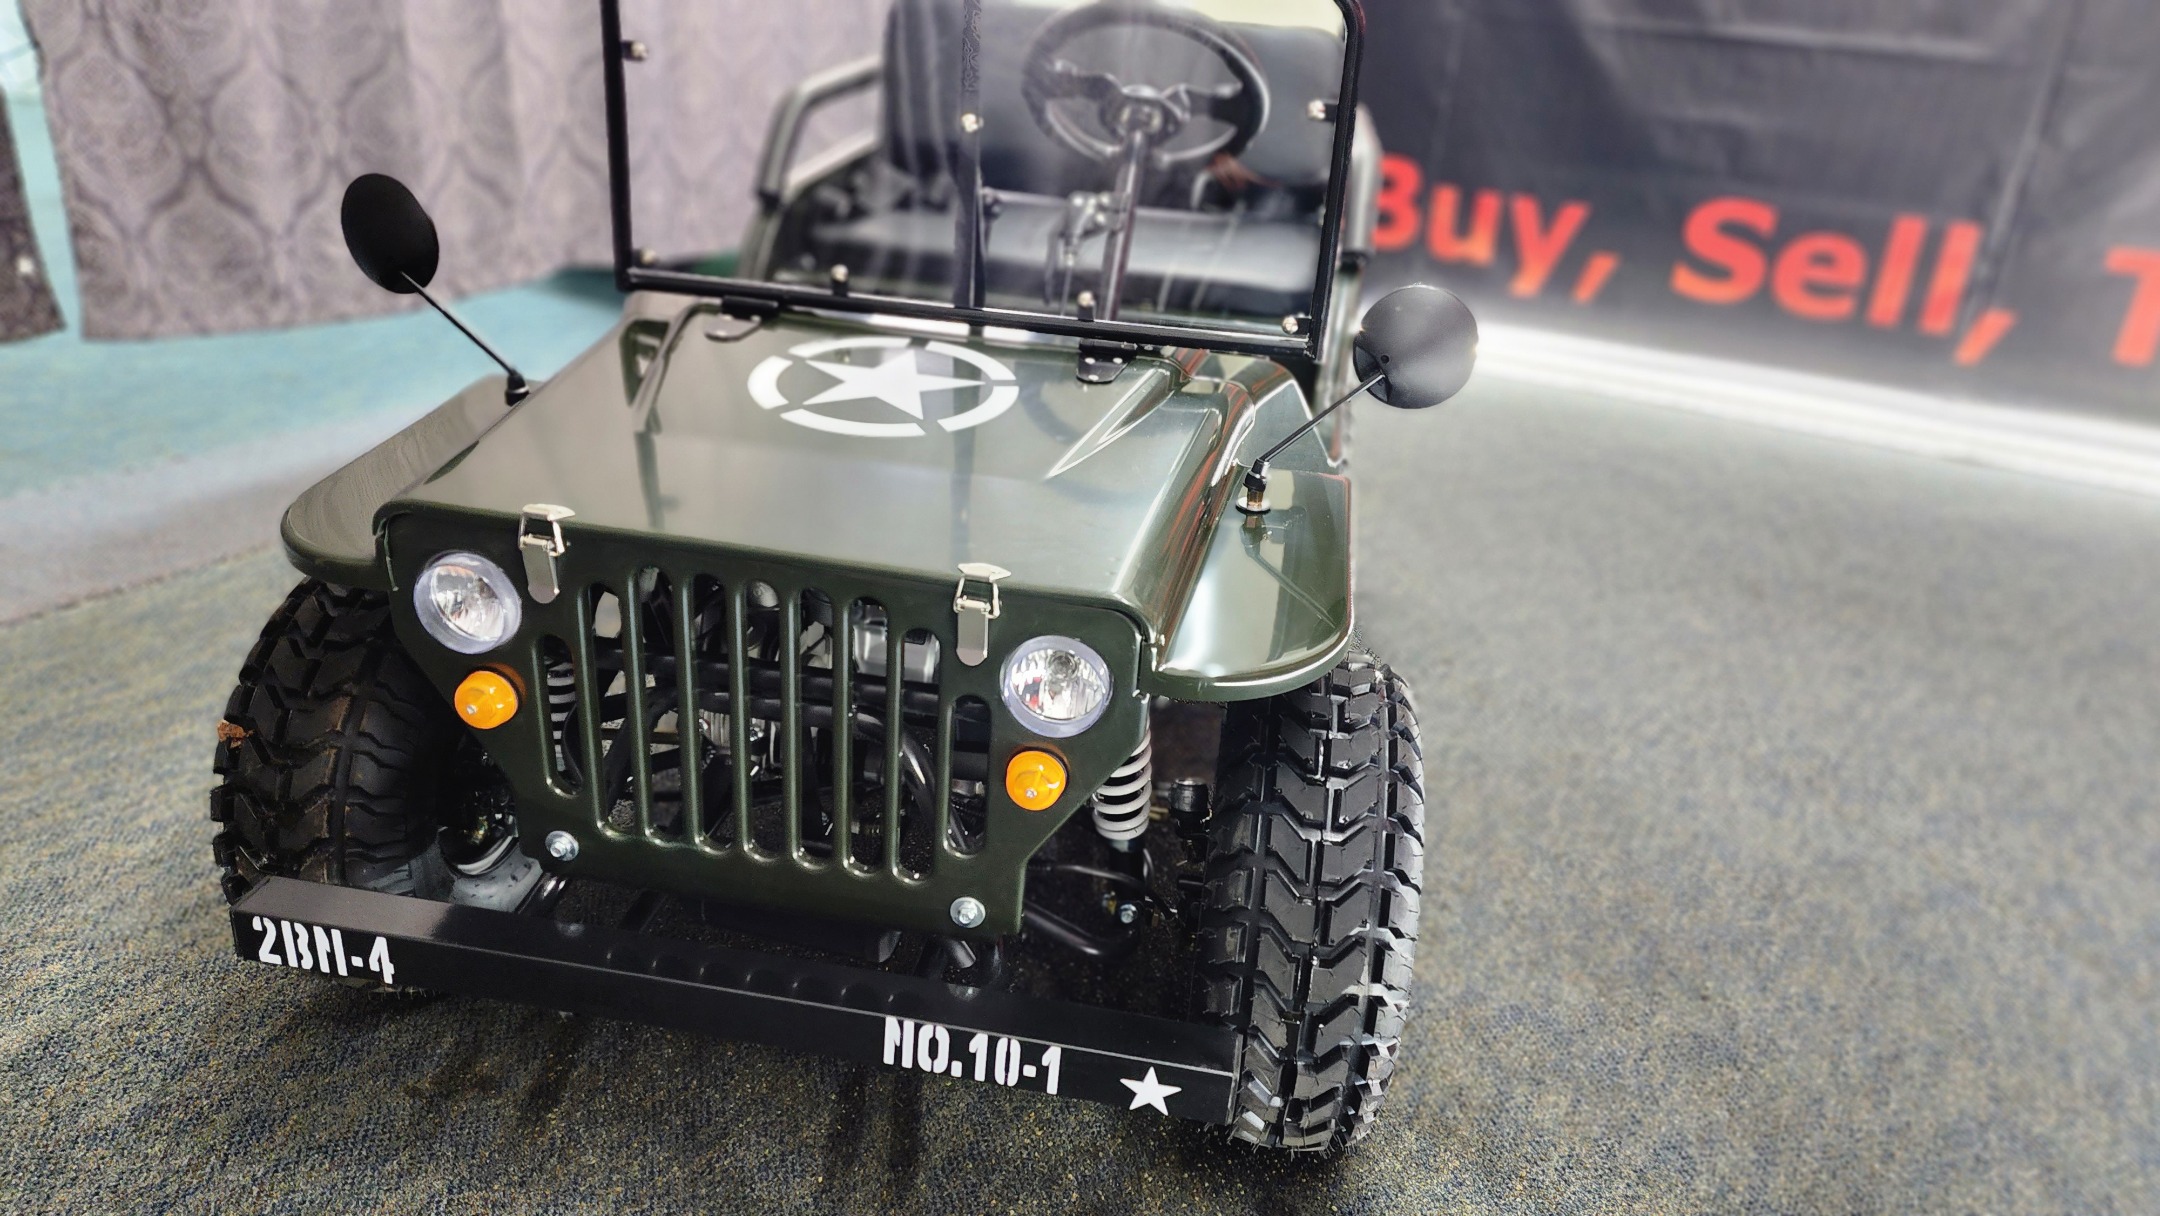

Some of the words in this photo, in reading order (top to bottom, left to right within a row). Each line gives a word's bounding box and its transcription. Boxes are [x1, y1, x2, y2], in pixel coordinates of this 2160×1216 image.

[1369, 153, 1619, 303] Buy,
[1670, 195, 2017, 366] Sell,
[252, 915, 395, 985] 2BN-4
[882, 1015, 1062, 1096] NO.10-1
